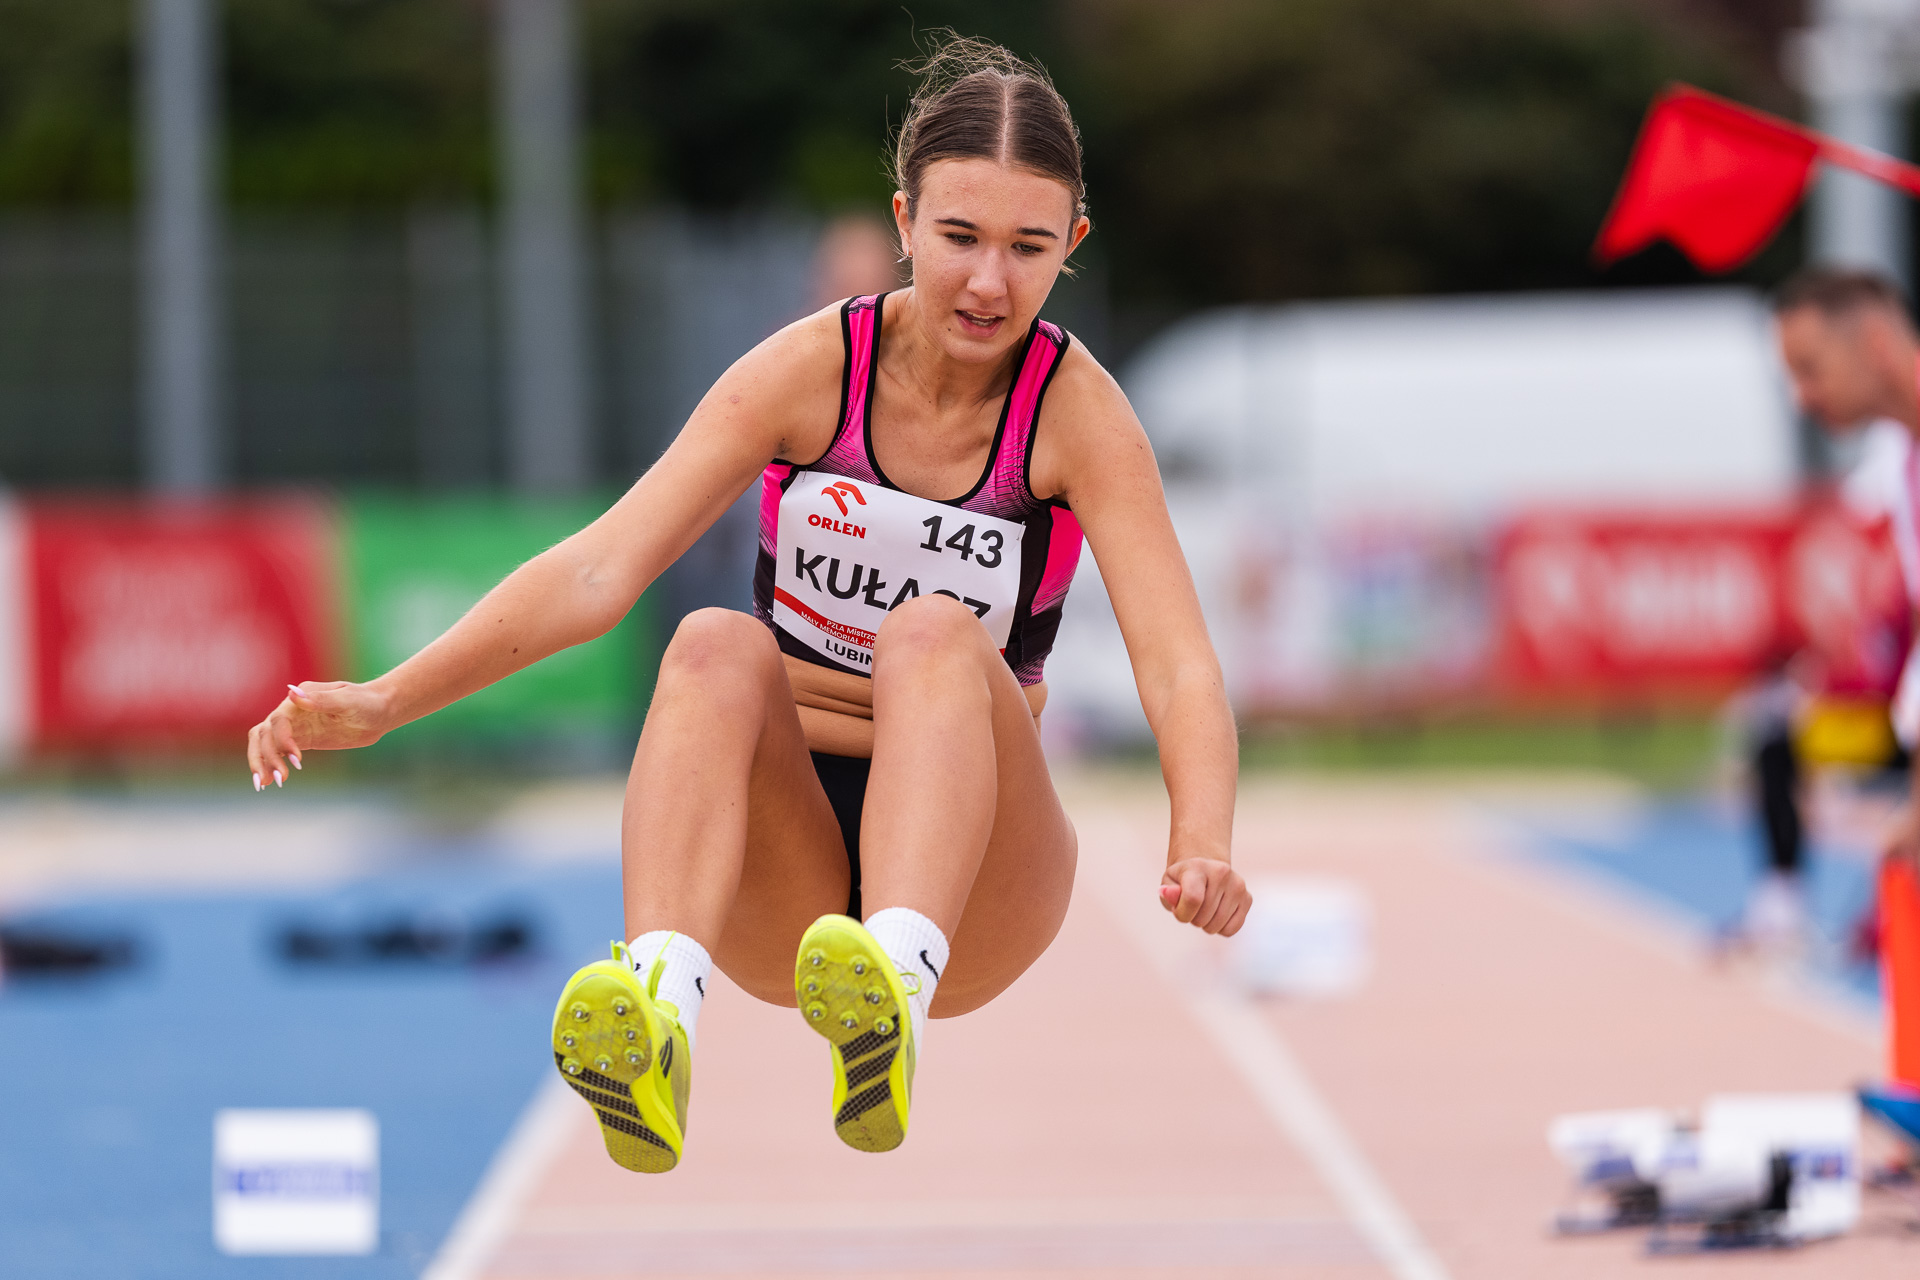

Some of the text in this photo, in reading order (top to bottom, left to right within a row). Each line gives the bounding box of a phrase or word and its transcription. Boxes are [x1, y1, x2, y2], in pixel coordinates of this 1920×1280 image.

[807, 513, 867, 540] ORLEN
[919, 515, 1004, 569] 143
[795, 546, 992, 619] KUŁA
[820, 623, 859, 645] MEMORIAŁ
[826, 620, 876, 641] PZLA Mistrzo
